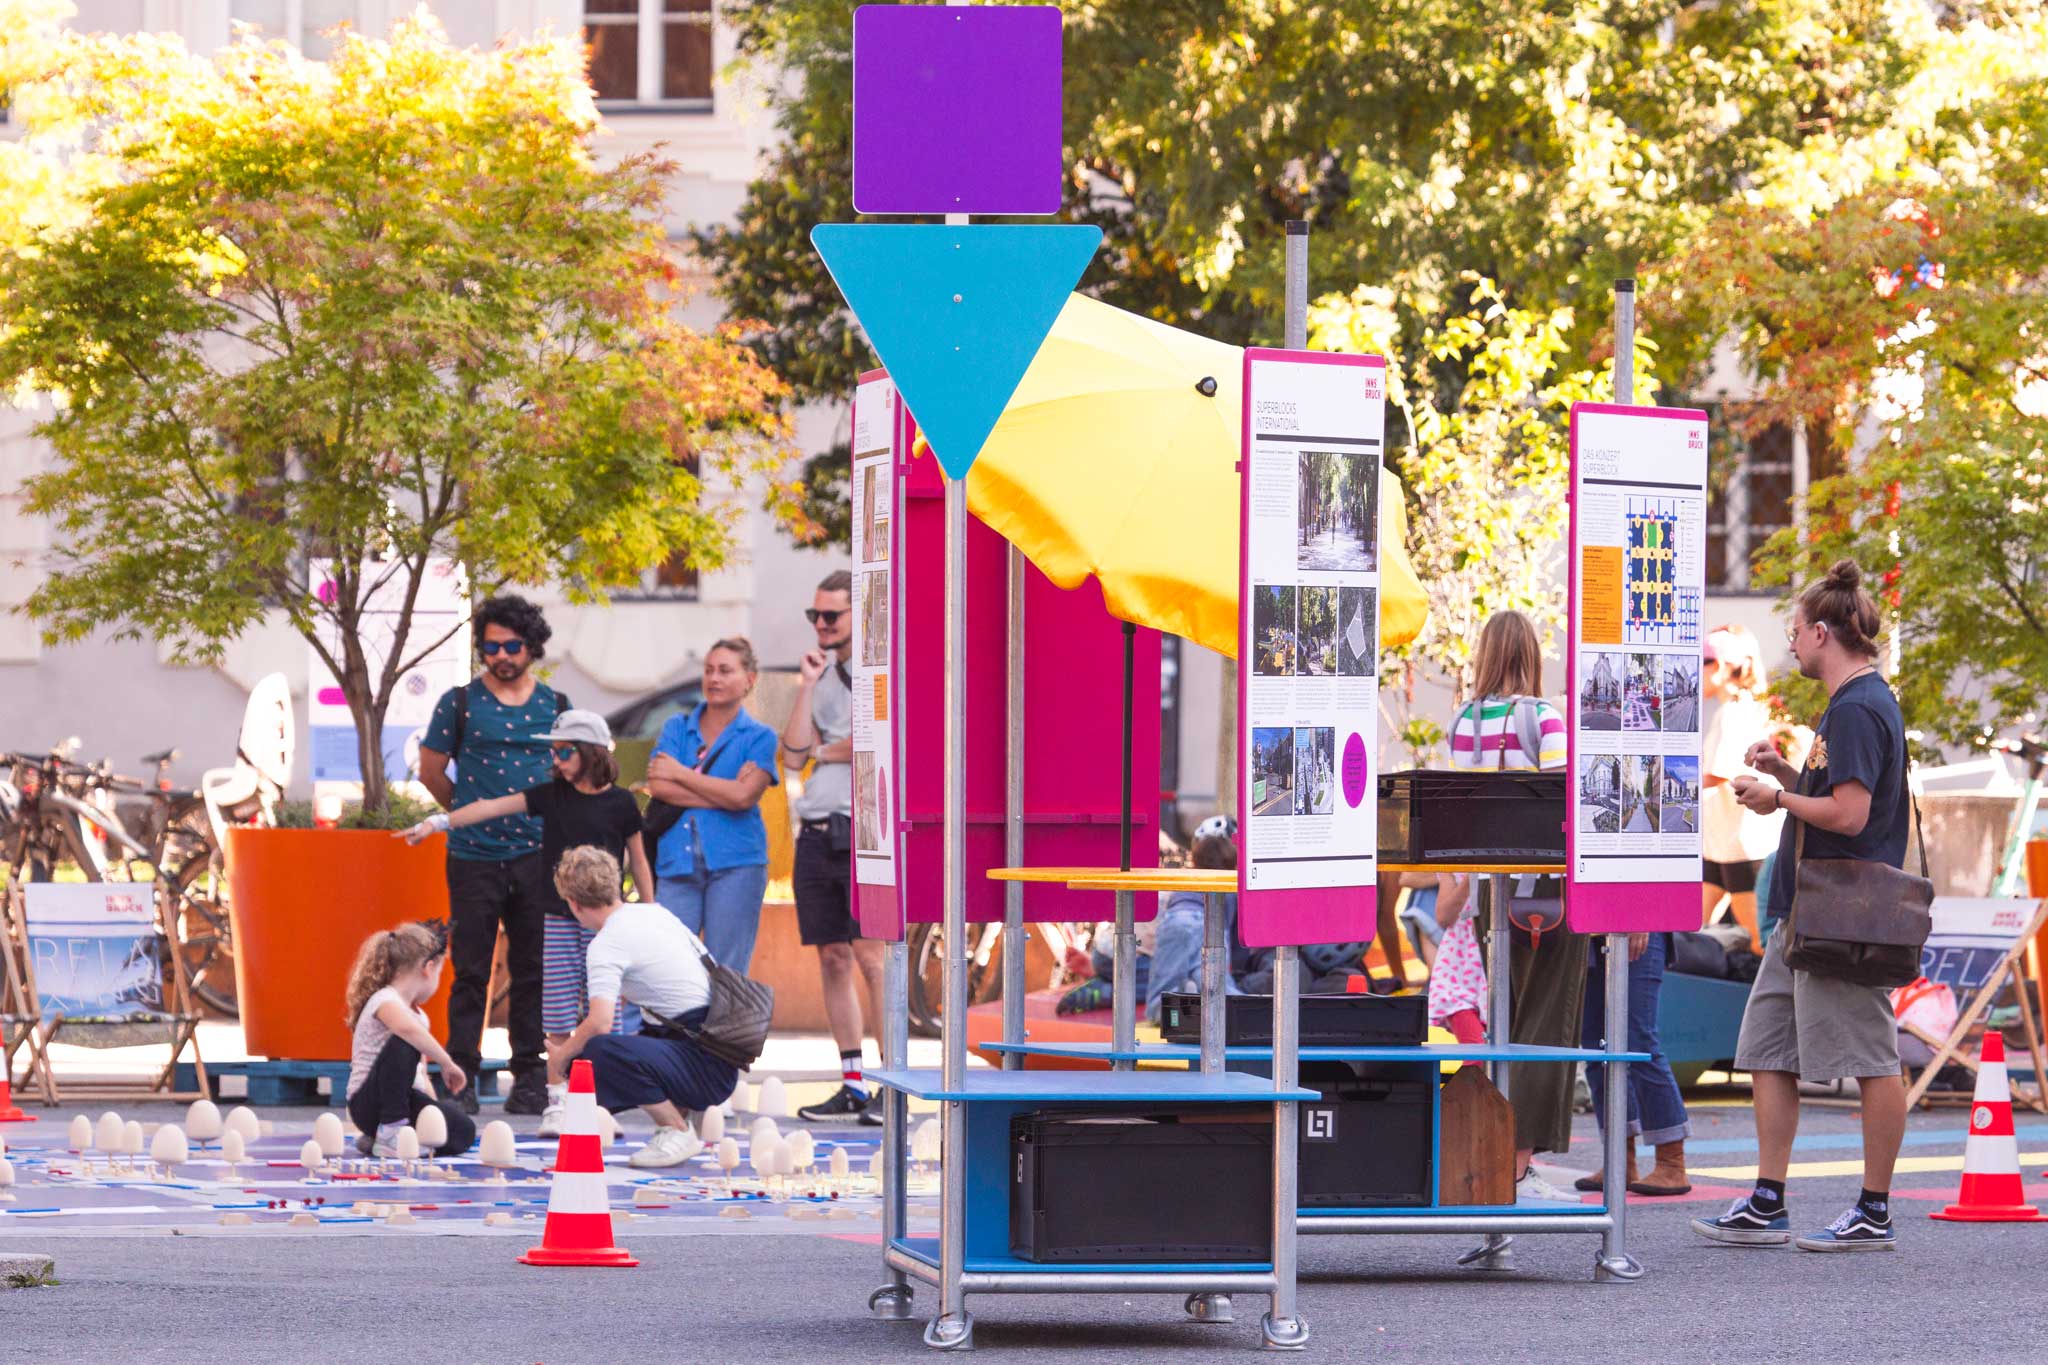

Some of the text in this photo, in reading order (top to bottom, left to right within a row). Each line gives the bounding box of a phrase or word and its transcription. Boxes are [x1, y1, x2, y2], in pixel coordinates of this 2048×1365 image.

[1365, 378, 1377, 389] INNS
[1365, 389, 1381, 400] BRUCK
[1256, 400, 1297, 415] SUPERBLOCKS
[1256, 416, 1301, 432] INTERNATIONAL
[1688, 430, 1700, 440] INNS
[1688, 440, 1704, 449] BRUCK
[1582, 462, 1619, 476] SUPERBLOCK
